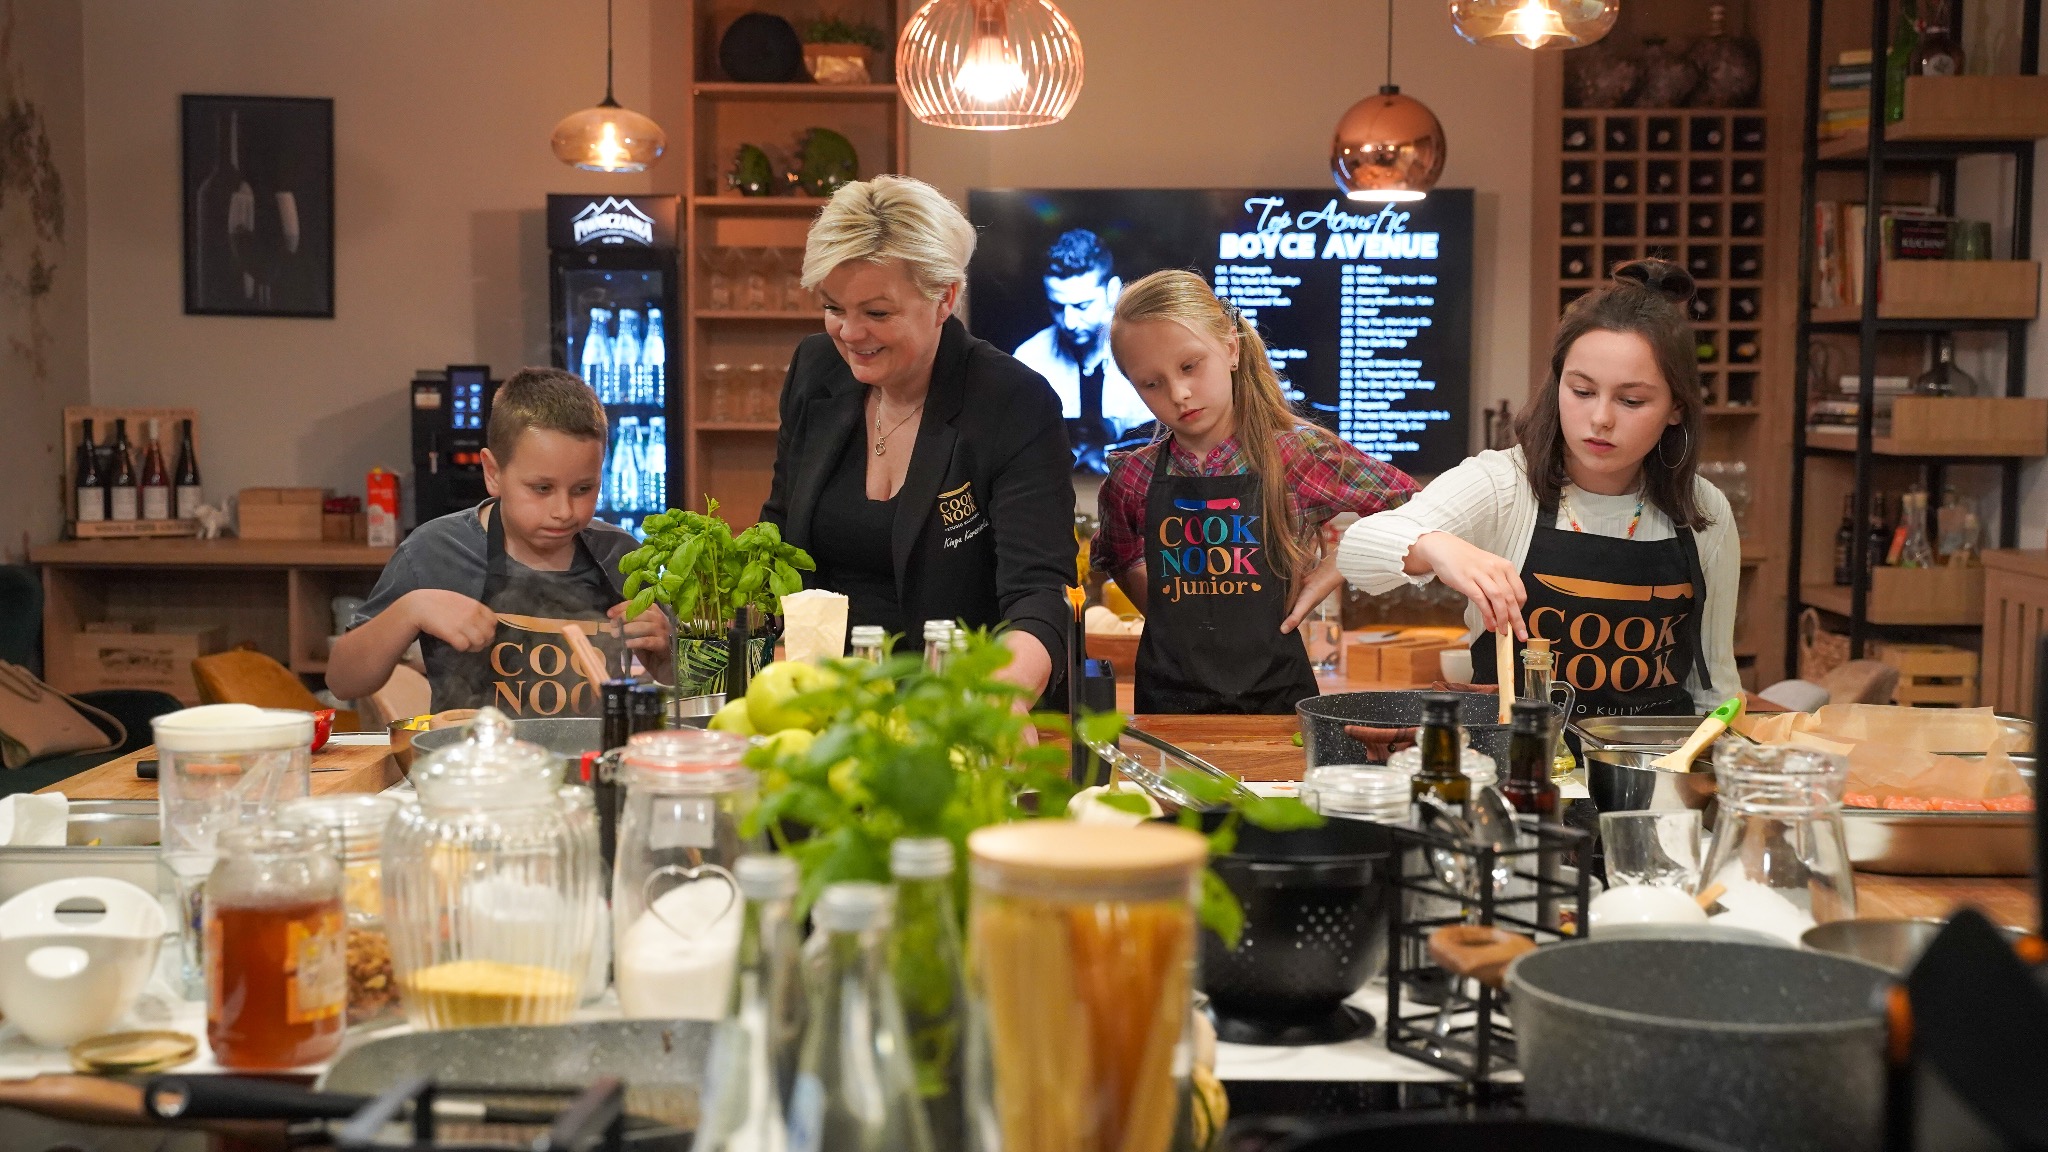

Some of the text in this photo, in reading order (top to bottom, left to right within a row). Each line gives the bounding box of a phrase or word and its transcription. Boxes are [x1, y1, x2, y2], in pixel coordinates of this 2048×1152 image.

[1219, 232, 1440, 259] BOYCE AVENUE
[939, 488, 975, 514] COOK
[942, 503, 977, 526] NOOK
[1159, 514, 1260, 547] COOK
[1160, 546, 1260, 577] NOOK
[1171, 576, 1249, 603] Junior
[1528, 606, 1688, 655] COOK
[490, 642, 607, 677] COO
[493, 680, 600, 716] NOO
